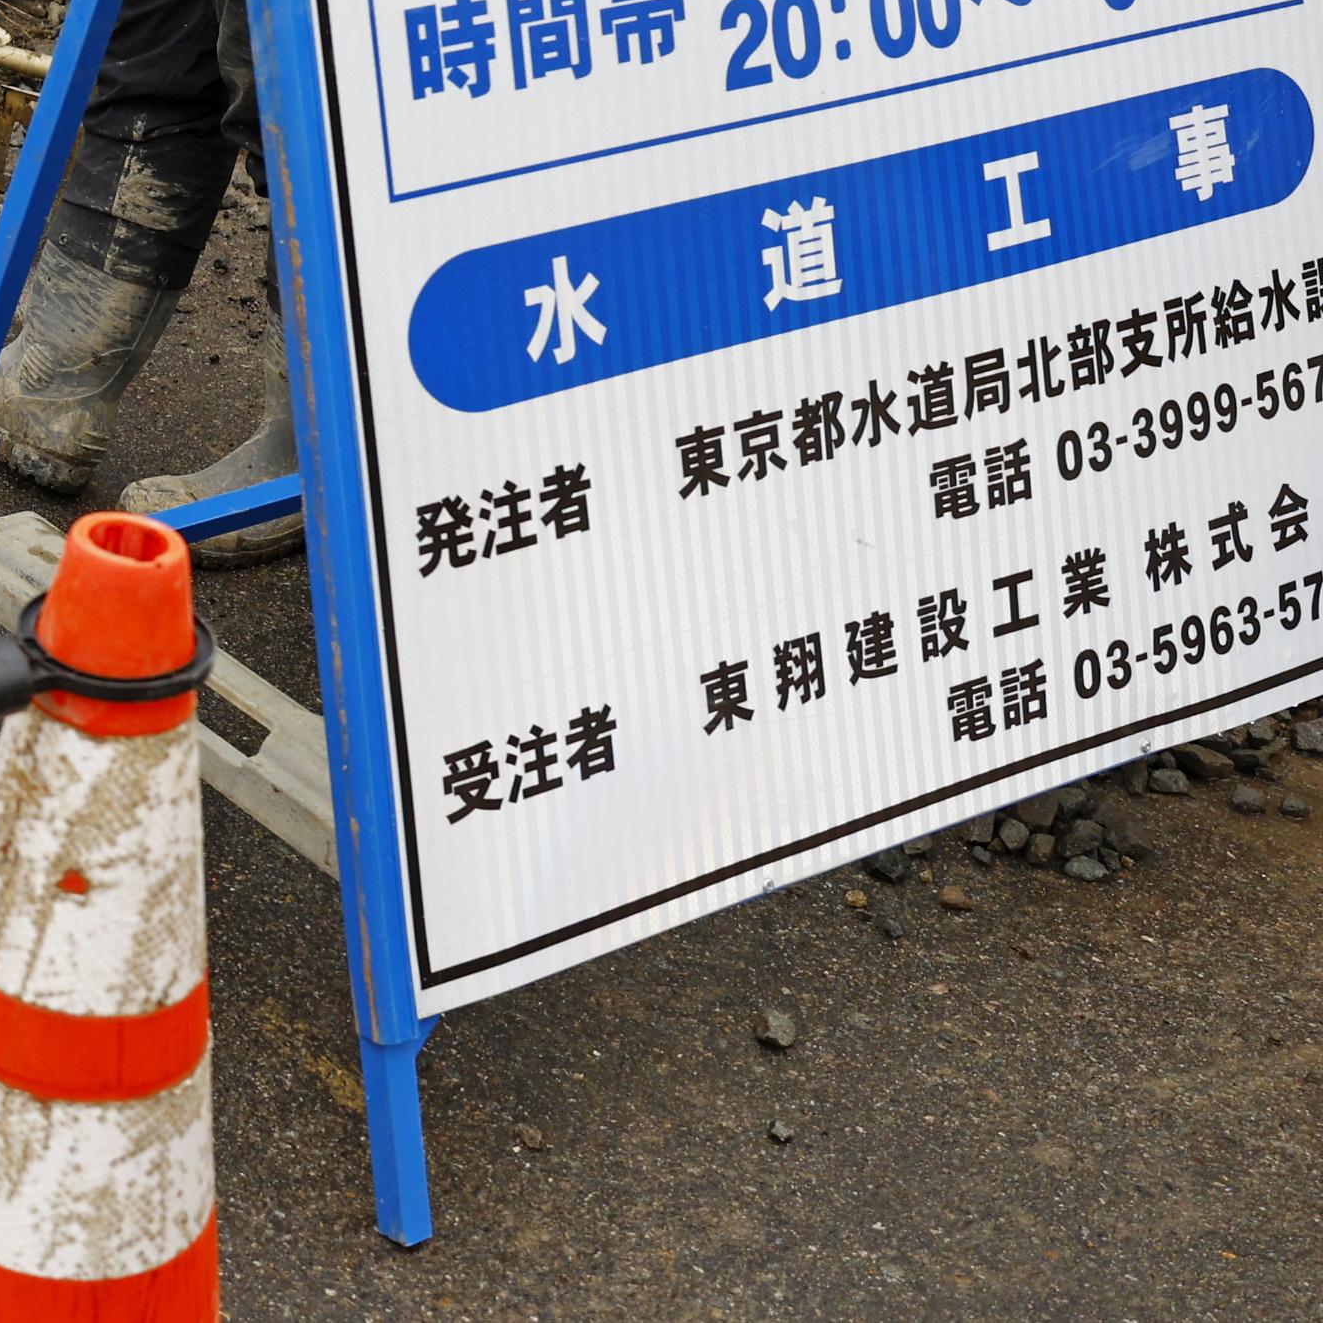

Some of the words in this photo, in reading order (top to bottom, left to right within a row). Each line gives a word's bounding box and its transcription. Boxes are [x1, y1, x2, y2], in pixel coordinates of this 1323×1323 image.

[524, 104, 1236, 364] 水道工事
[415, 462, 591, 578] 発注者
[929, 437, 1032, 520] 電話
[1056, 353, 1323, 481] 03-3999-567
[947, 658, 1048, 742] 電話
[1074, 570, 1323, 700] 03-5963-57
[442, 704, 617, 825] 受注者
